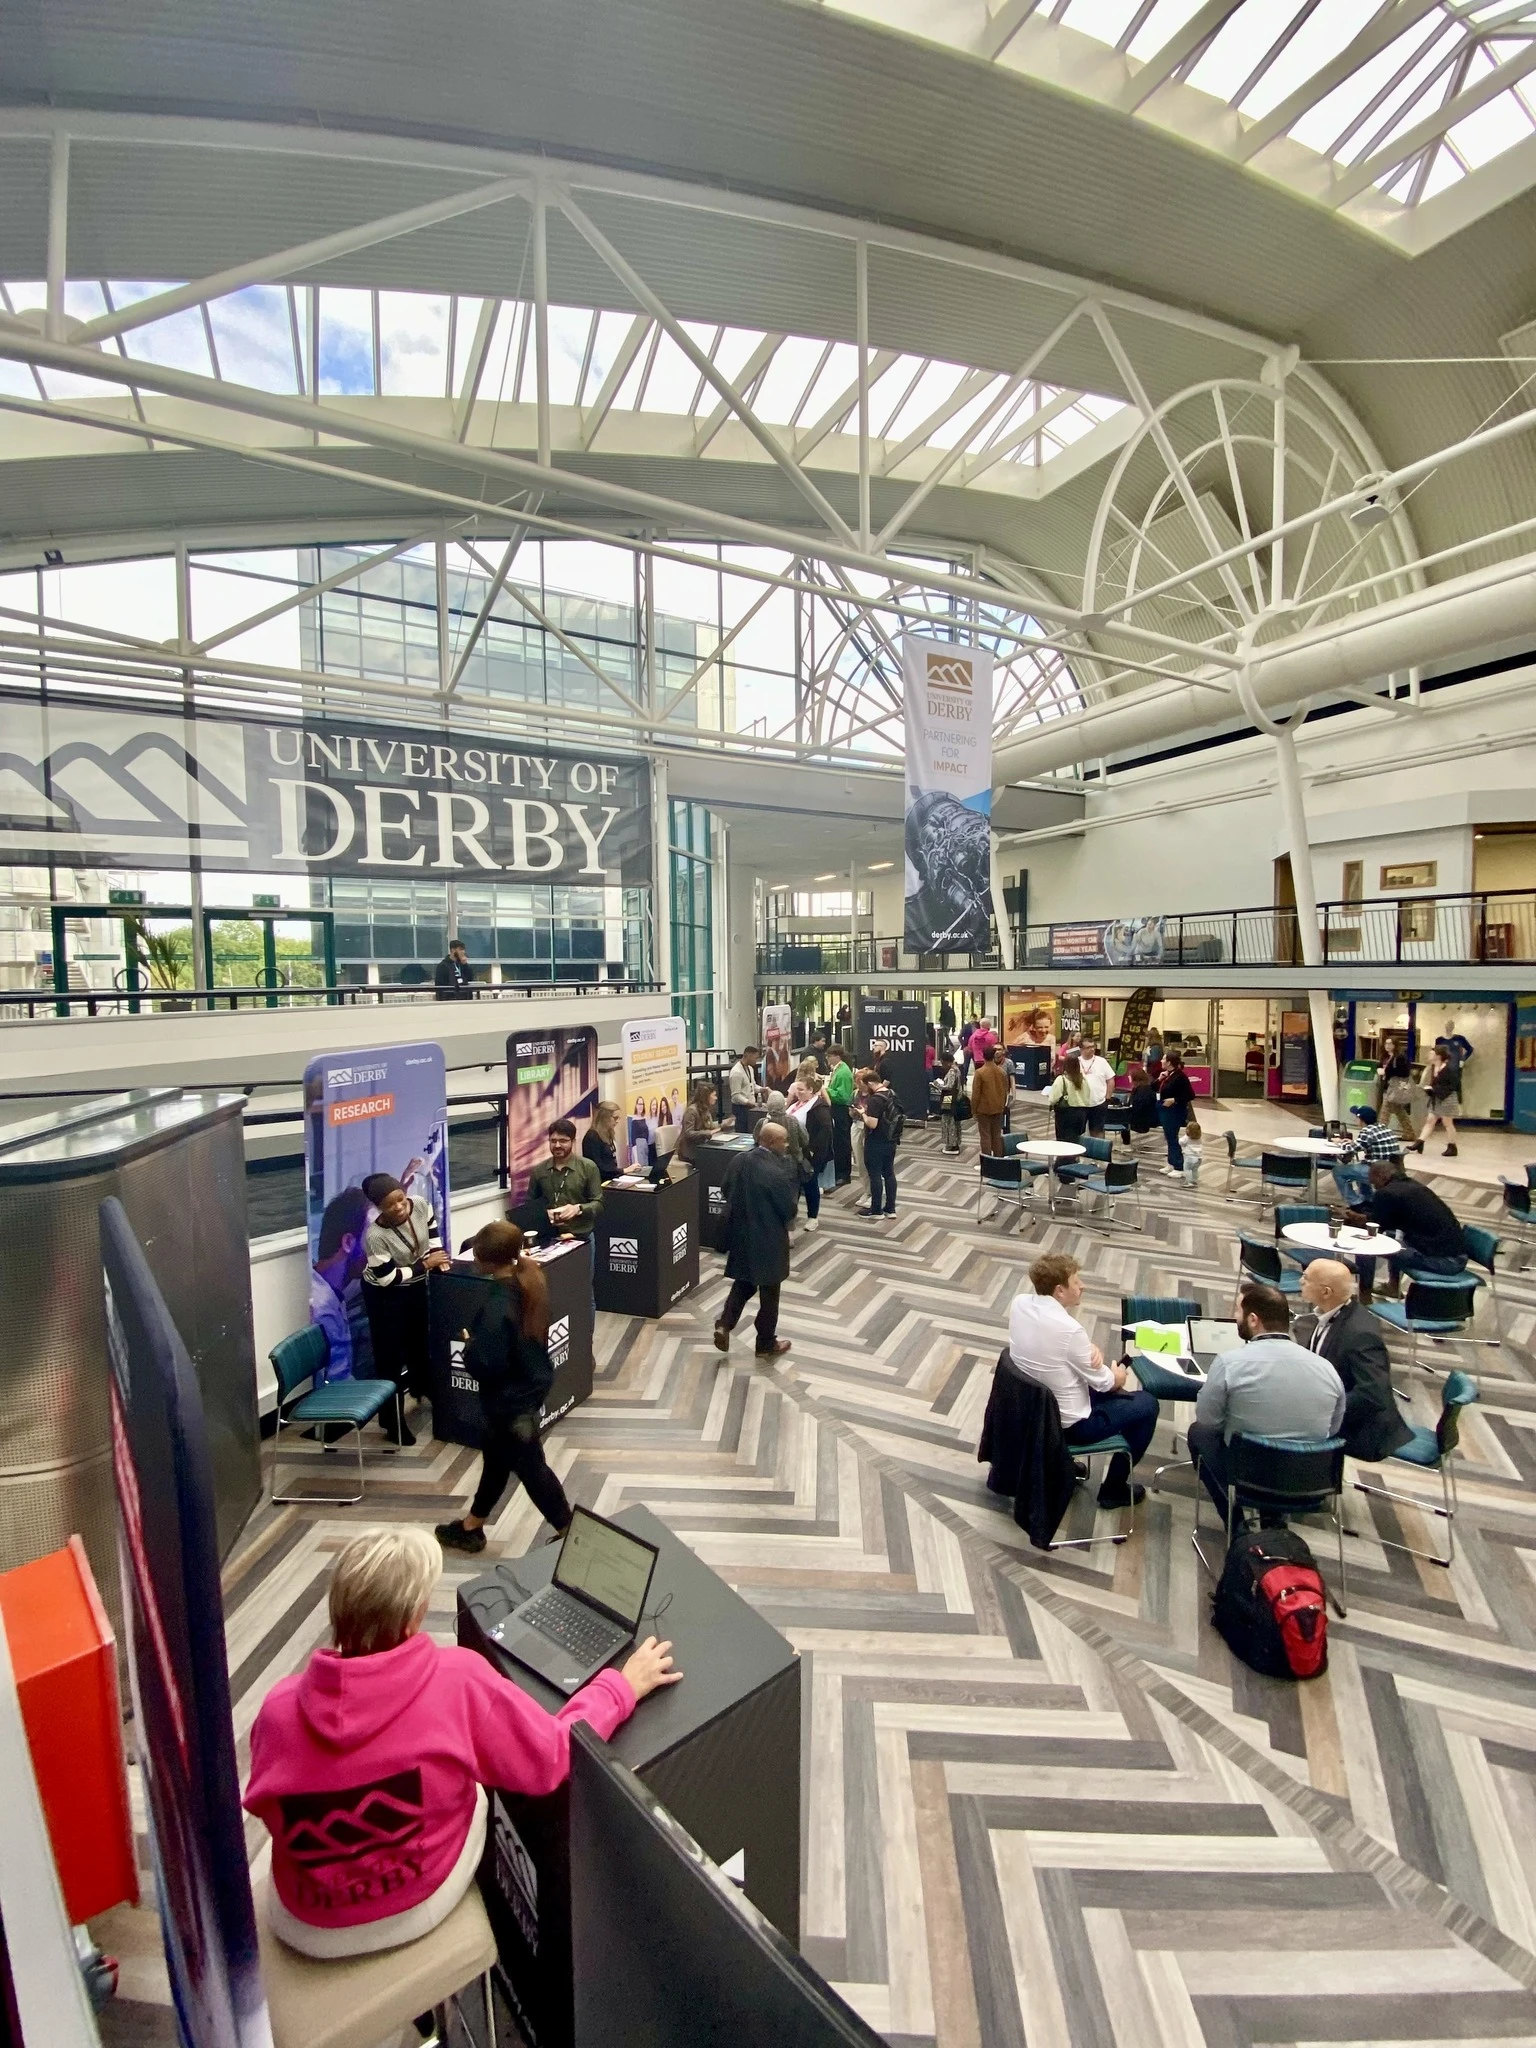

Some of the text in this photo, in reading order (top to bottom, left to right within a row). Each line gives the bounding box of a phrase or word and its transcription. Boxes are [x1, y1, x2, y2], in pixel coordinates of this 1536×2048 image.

[927, 692, 963, 705] UNIVERSITY
[928, 700, 973, 721] DERBY
[923, 729, 977, 747] PARTNERING
[941, 746, 959, 759] FOR
[265, 728, 620, 795] UNIVERSITY OF
[934, 760, 968, 774] IMPACT
[268, 778, 621, 874] DERBY
[931, 931, 969, 940] derby.ac.uk
[1062, 1008, 1080, 1020] CAMPUS
[873, 1025, 910, 1038] INFO
[1061, 1018, 1080, 1031] TOURS
[533, 1044, 556, 1055] DERBY
[353, 1068, 388, 1084] DERBY
[520, 1067, 551, 1081] LIBRARY
[333, 1098, 391, 1121] RESEARCH
[609, 1264, 639, 1274] DERBY
[553, 1349, 570, 1369] RBY
[451, 1376, 480, 1392] DERB
[297, 1843, 424, 1909] DERBY
